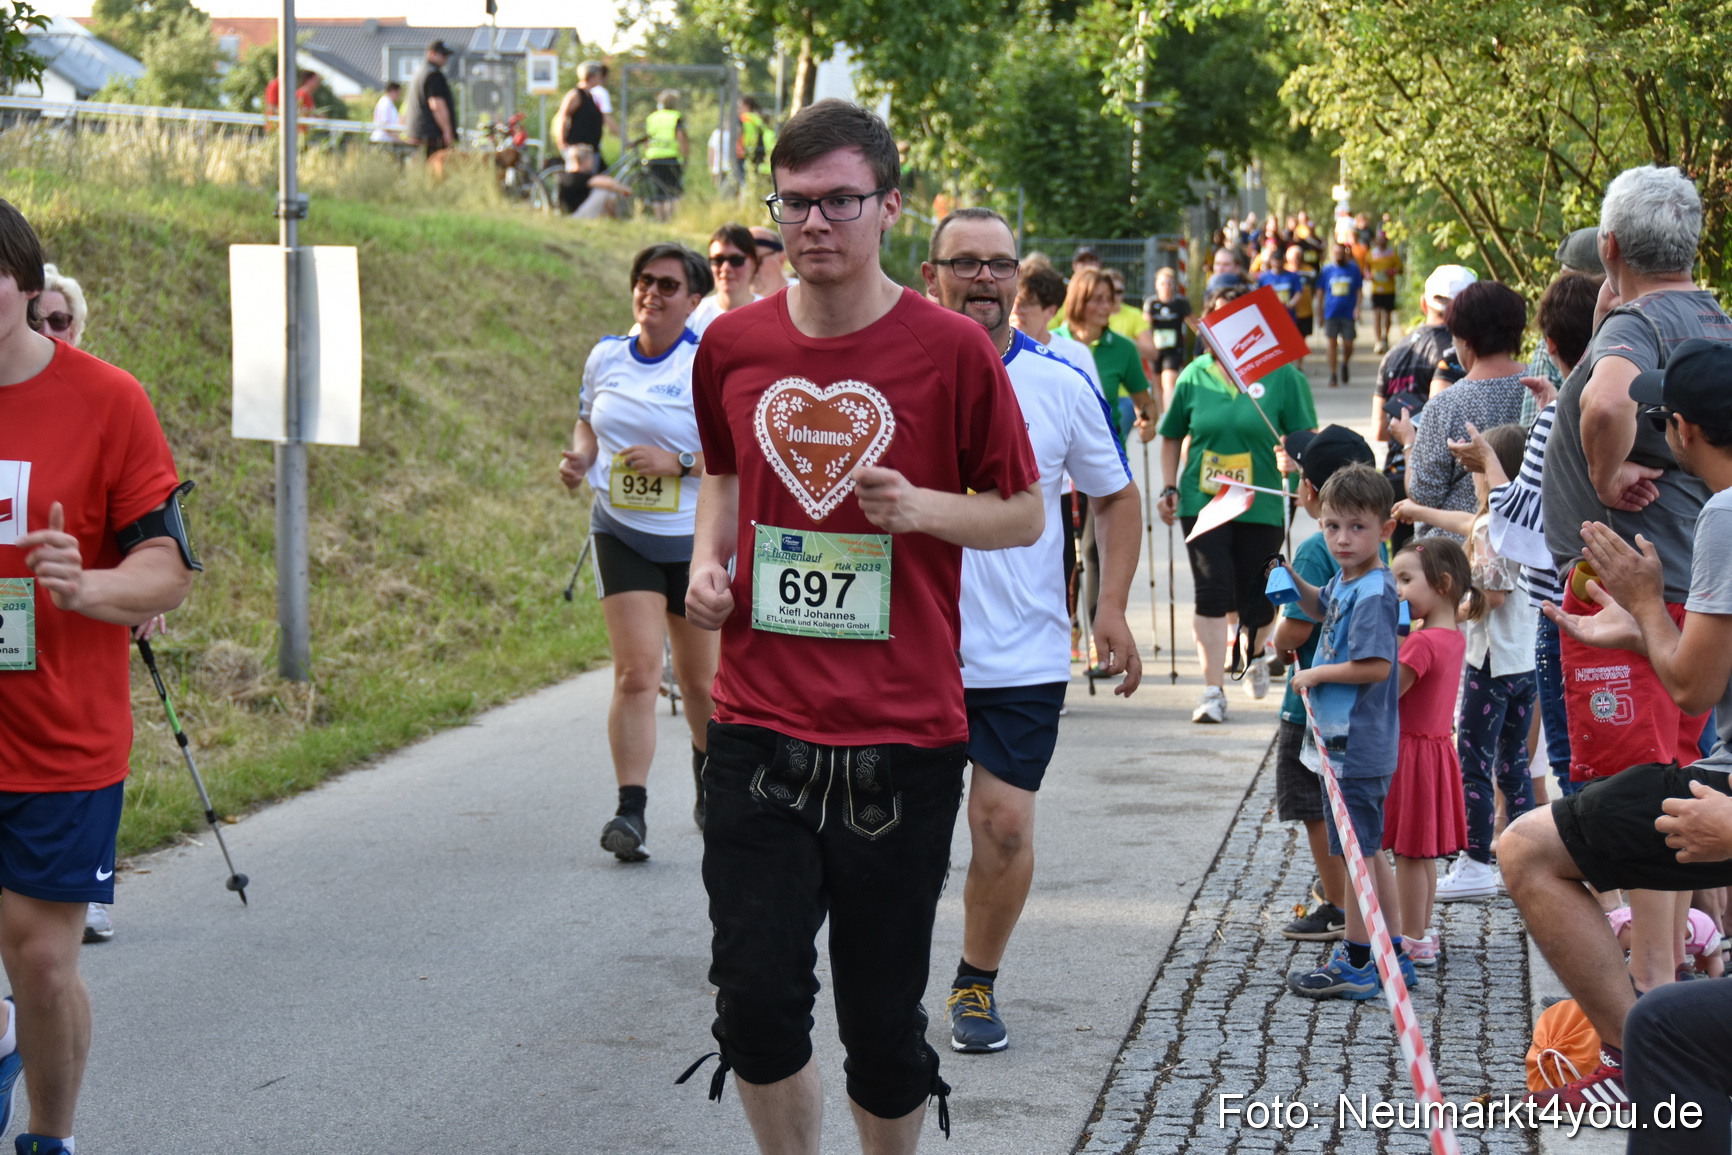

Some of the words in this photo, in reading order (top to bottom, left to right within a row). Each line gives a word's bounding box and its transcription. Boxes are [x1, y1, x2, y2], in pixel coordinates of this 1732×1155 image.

[786, 425, 853, 447] Johannes
[622, 475, 663, 496] 934
[772, 547, 823, 563] firmenlauf
[855, 563, 881, 572] 2019
[779, 568, 856, 609] 697
[3, 603, 26, 611] 2019
[803, 609, 856, 621] Johannes
[766, 614, 797, 625] ETL-Lenk
[798, 618, 812, 627] und
[813, 620, 845, 630] Kollegen
[846, 621, 870, 630] GmbH
